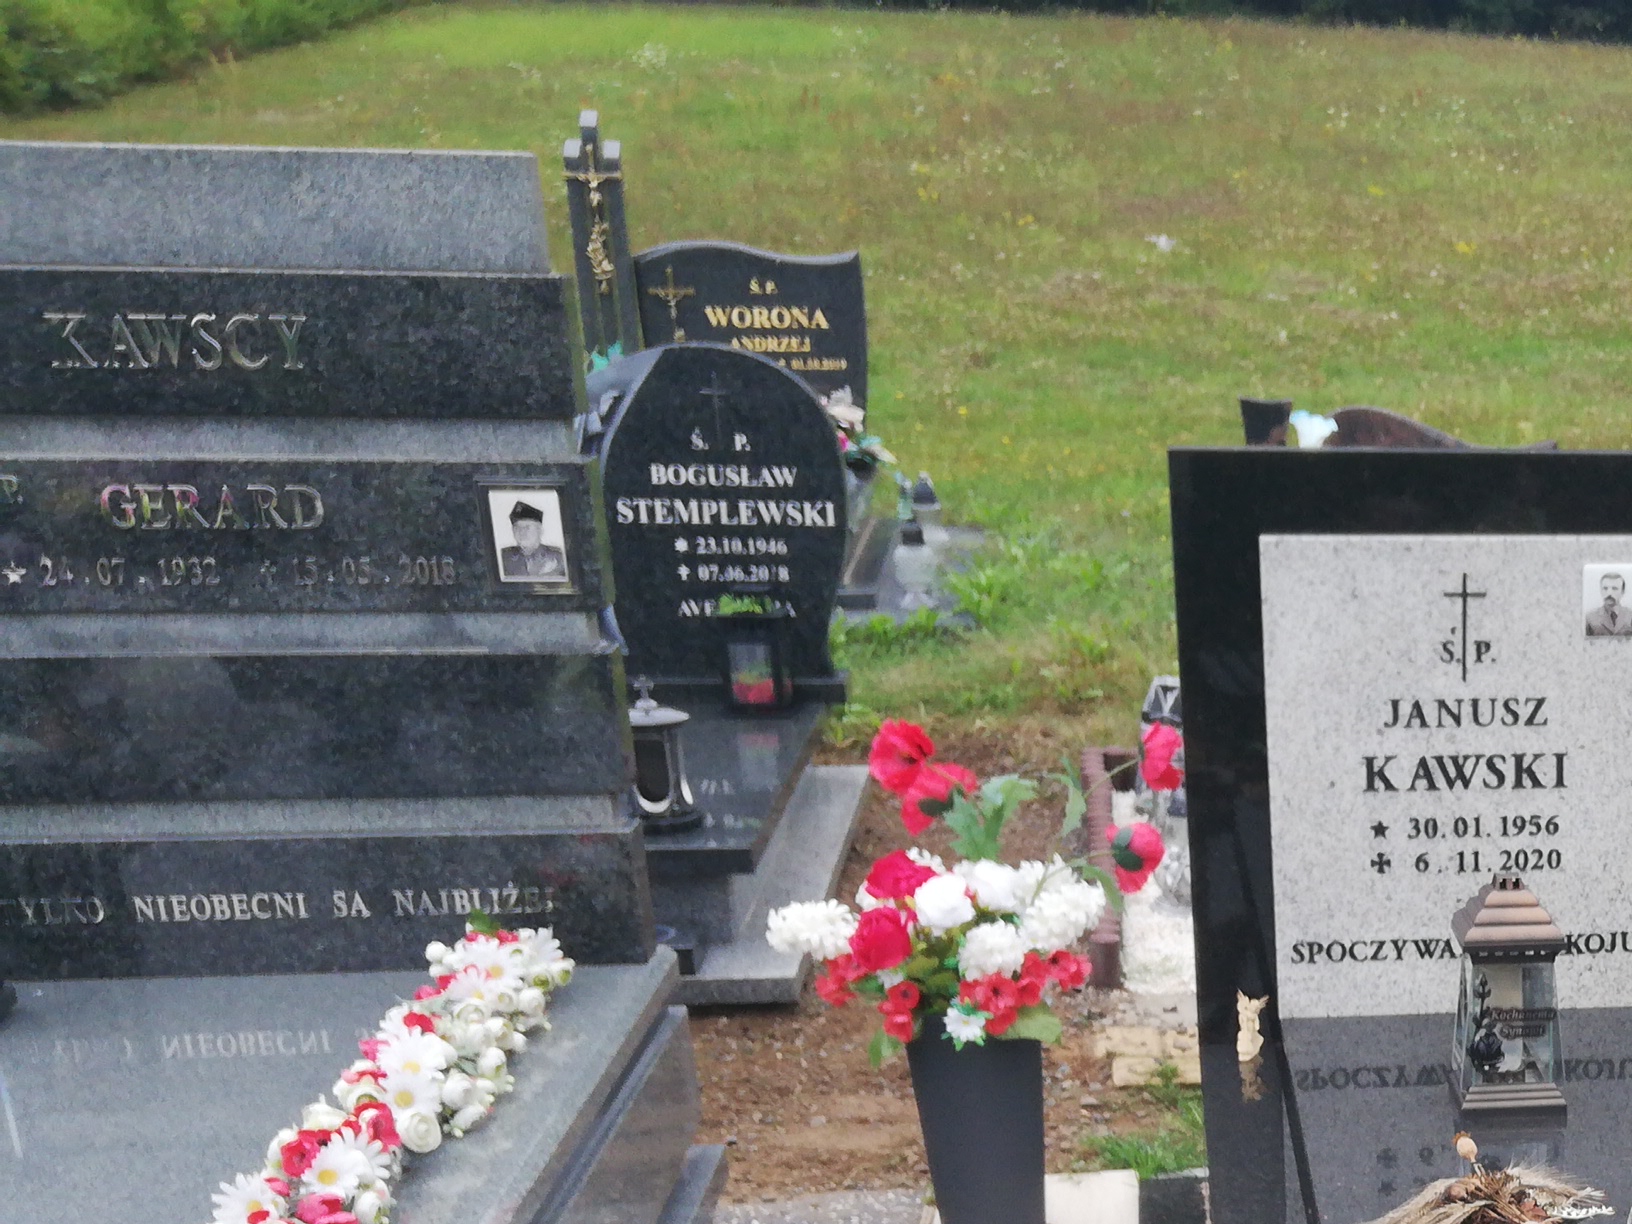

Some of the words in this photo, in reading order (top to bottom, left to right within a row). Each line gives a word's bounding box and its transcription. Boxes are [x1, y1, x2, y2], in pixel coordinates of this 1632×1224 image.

[703, 304, 830, 330] WORONA
[42, 312, 307, 371] KAWSCY
[731, 334, 811, 353] ANDRZEJ
[100, 482, 325, 531] GERARD
[616, 497, 837, 528] STEMPLEWSKI
[1474, 640, 1497, 664] P.
[1383, 696, 1549, 729] JANUSZ
[1361, 752, 1569, 793] KAWSKI
[131, 891, 310, 924] NIEOBECNI
[1290, 939, 1462, 965] SPOCZYWA
